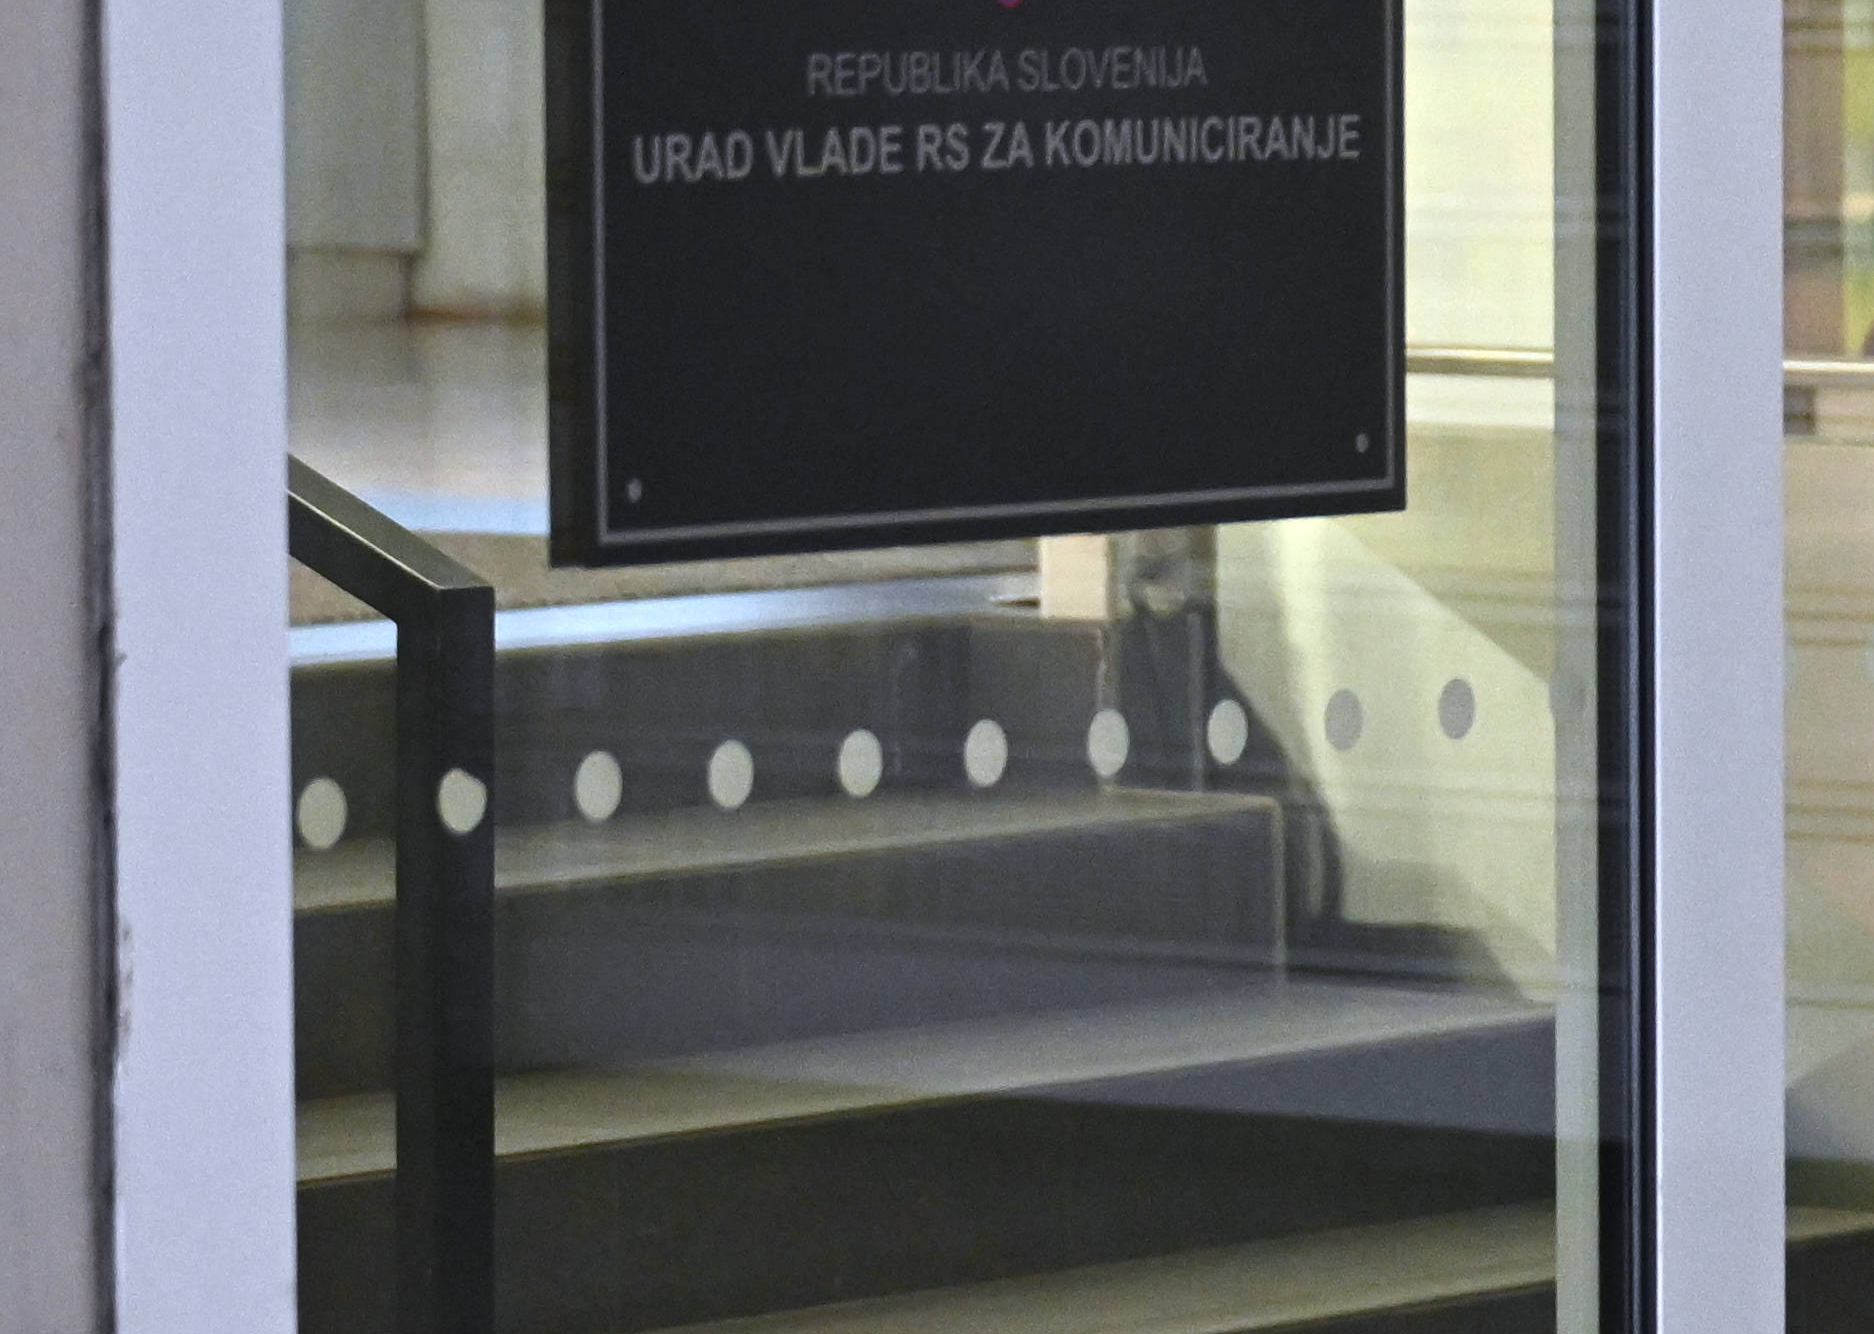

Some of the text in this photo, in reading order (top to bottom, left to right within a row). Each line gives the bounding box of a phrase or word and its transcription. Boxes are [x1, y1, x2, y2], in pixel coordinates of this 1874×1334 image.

[806, 46, 1208, 97] REPUBLIKA SLOVENIJA
[632, 114, 1361, 184] URAD VLADE RS ZA KOMUNICIRANJE
